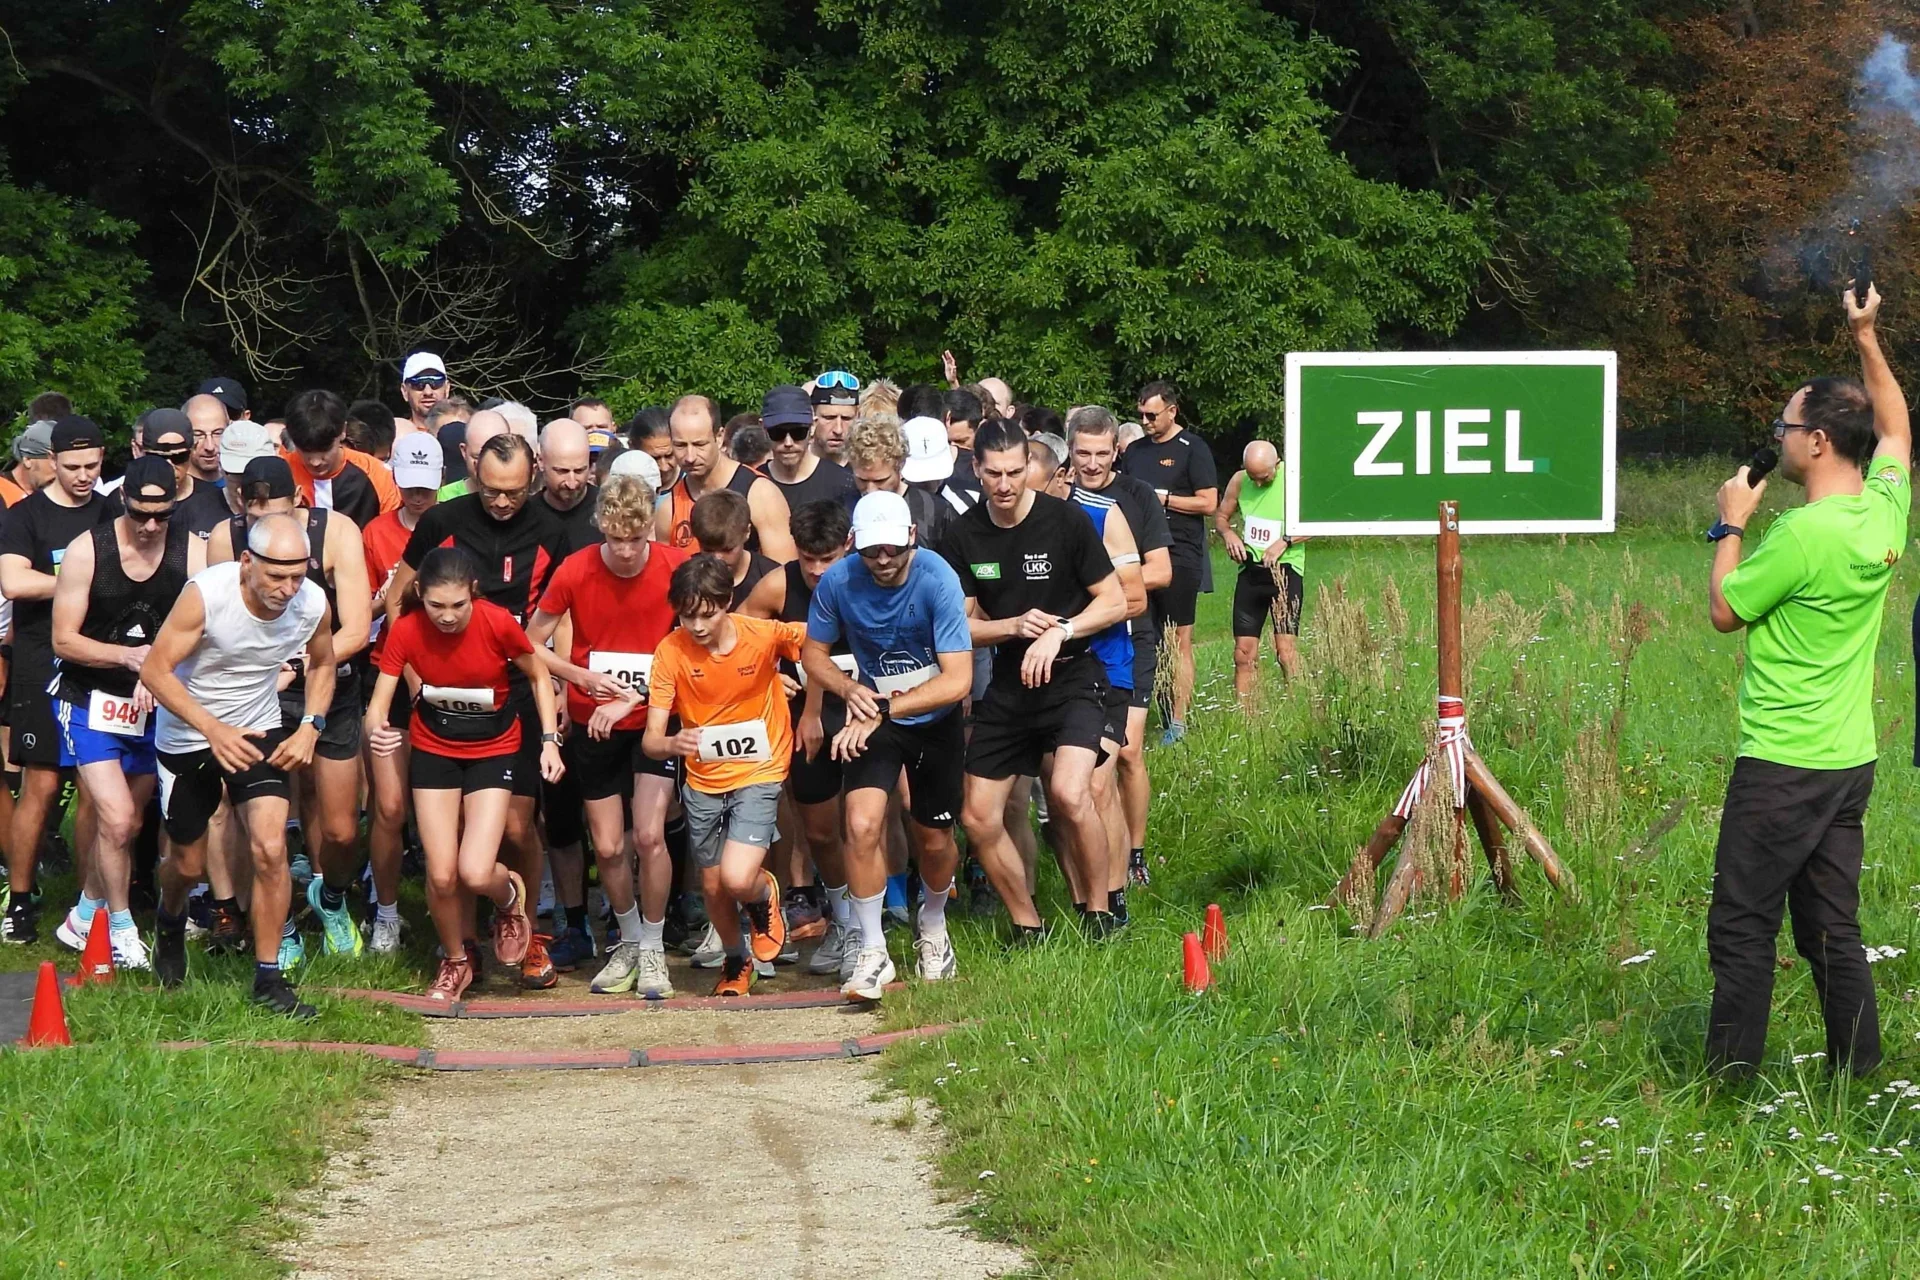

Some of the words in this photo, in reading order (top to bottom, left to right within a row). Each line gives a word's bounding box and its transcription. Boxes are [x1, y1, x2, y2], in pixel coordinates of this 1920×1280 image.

[1354, 409, 1533, 475] ZIEL
[1251, 527, 1270, 542] 919
[1026, 563, 1047, 572] LKK
[102, 700, 140, 725] 948
[437, 700, 482, 711] 106
[711, 737, 758, 757] 102
